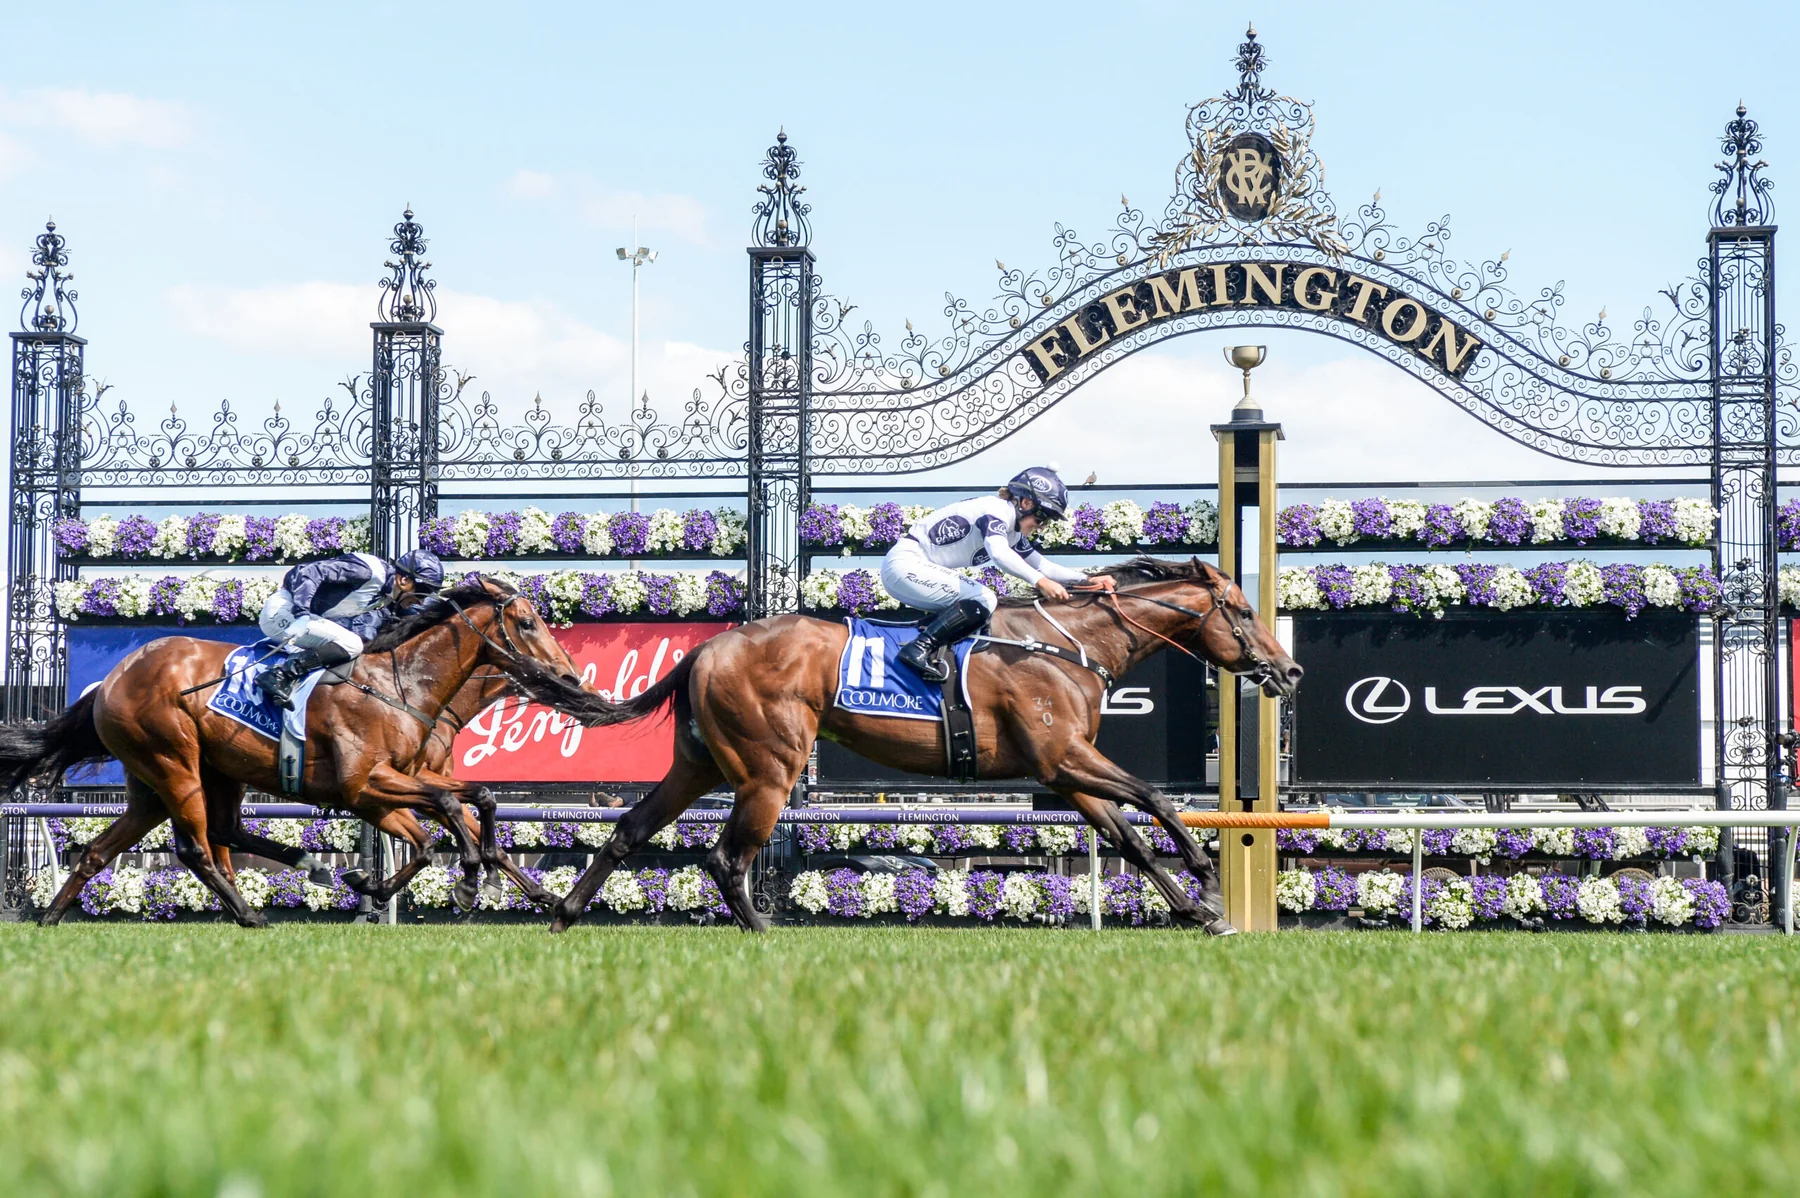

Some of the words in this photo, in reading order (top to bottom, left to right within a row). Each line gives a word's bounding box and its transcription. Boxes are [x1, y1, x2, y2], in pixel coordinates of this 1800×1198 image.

[1026, 263, 1481, 381] FLEMINGTON
[905, 572, 938, 589] Rachel
[846, 634, 885, 688] 11
[841, 688, 924, 710] COOLMORE
[1425, 686, 1647, 714] LEXUS
[542, 810, 602, 820] FLEMINGTON
[677, 811, 723, 821] MINGTON
[779, 812, 840, 821] FLEMINGTON
[897, 812, 960, 822] FLEMINGTON
[1016, 813, 1079, 823] FLEMINGTON
